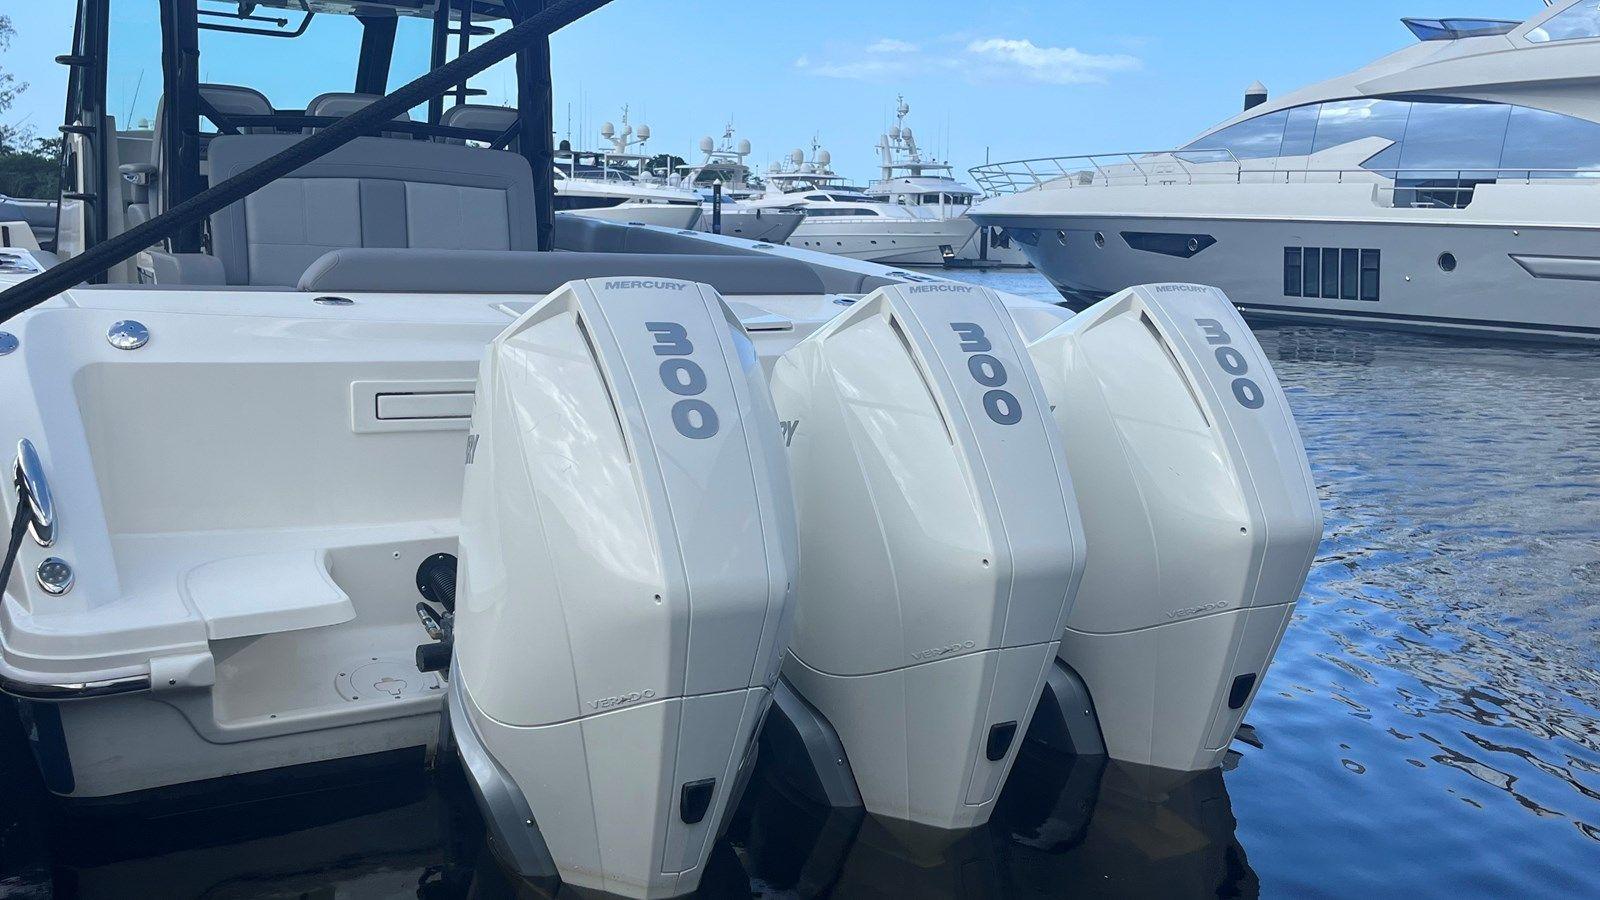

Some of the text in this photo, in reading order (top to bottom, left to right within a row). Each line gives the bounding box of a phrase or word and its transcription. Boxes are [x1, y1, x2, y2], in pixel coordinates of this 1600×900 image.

[604, 280, 687, 291] MERCURY
[909, 284, 973, 294] MERCURY
[1155, 285, 1207, 293] MERCURY
[949, 322, 1023, 426] 300
[1193, 318, 1265, 410] 300
[644, 321, 720, 440] 300
[1165, 600, 1228, 619] VERADO
[911, 640, 976, 661] VERADO
[587, 688, 656, 709] VERADO
